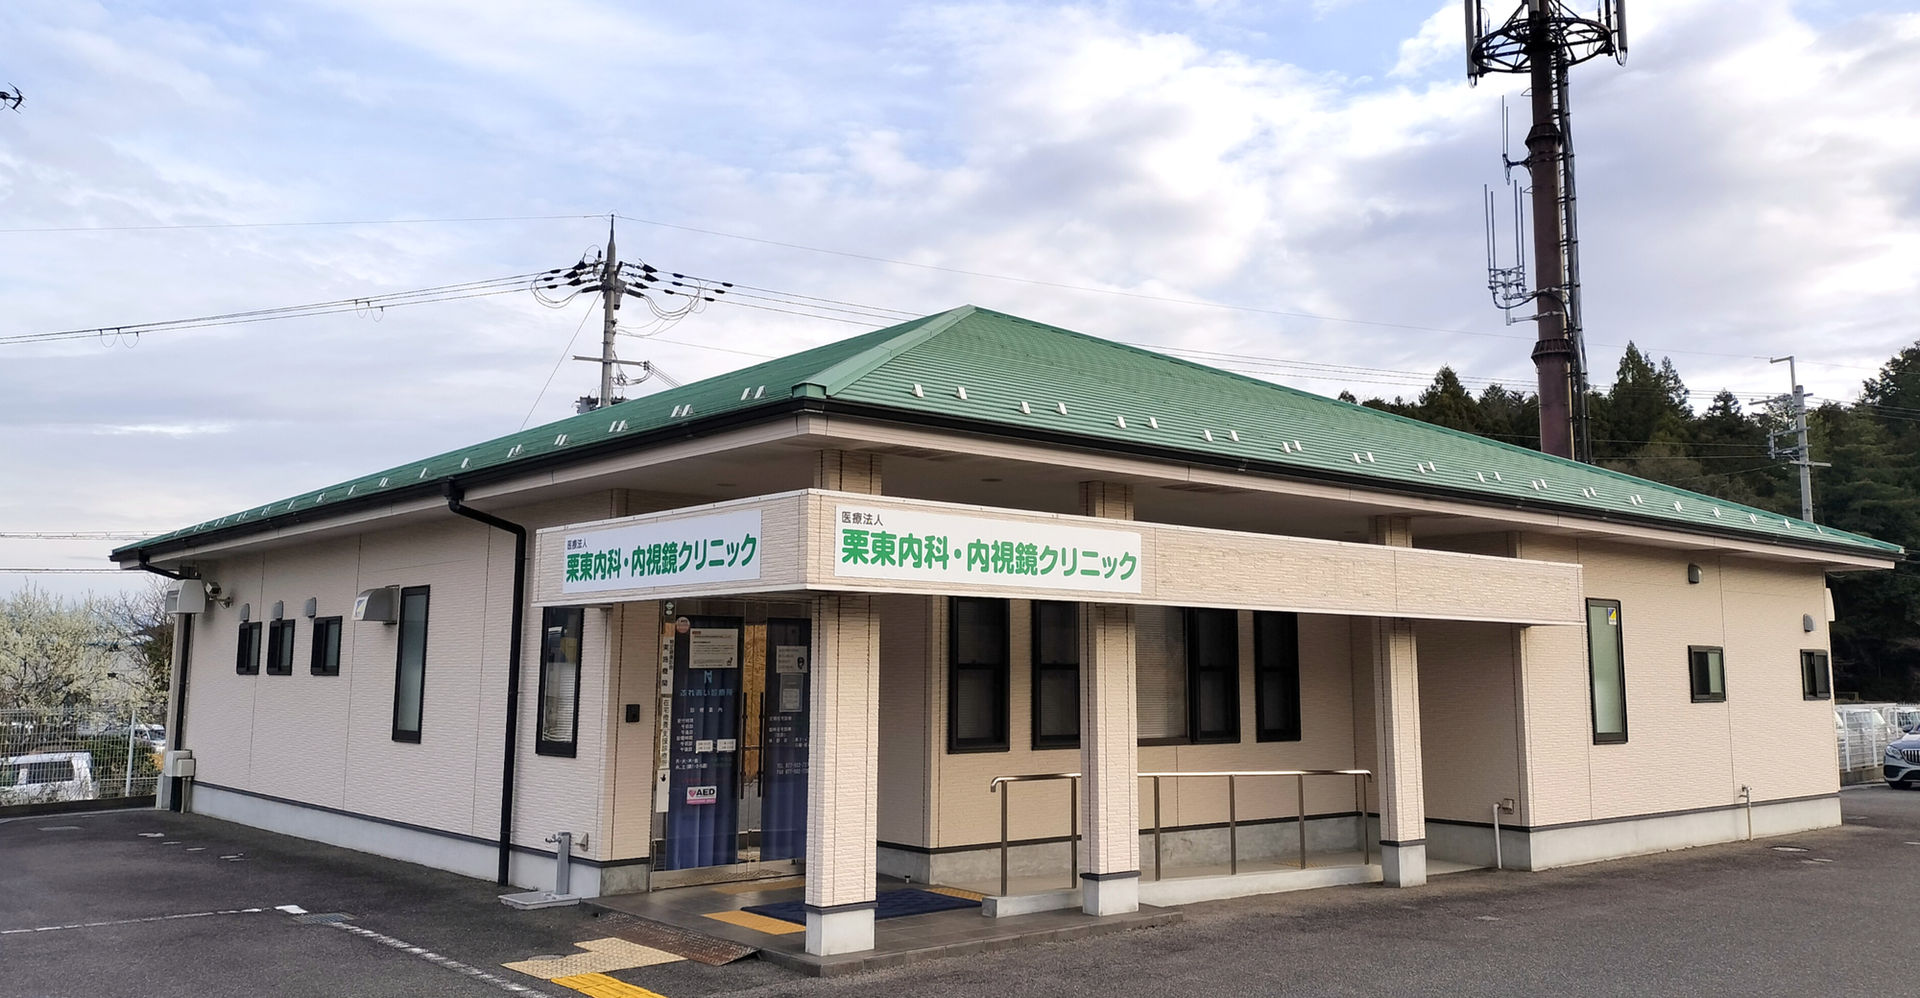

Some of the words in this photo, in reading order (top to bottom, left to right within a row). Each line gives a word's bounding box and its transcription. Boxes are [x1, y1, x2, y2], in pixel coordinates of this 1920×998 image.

[840, 510, 884, 527] 医療法人
[566, 537, 588, 551] 医療法人
[565, 532, 757, 584] 栗東内科・内視鏡クリニック
[841, 528, 1138, 582] 栗東内科・内視鏡クリニック
[696, 788, 716, 796] AED
